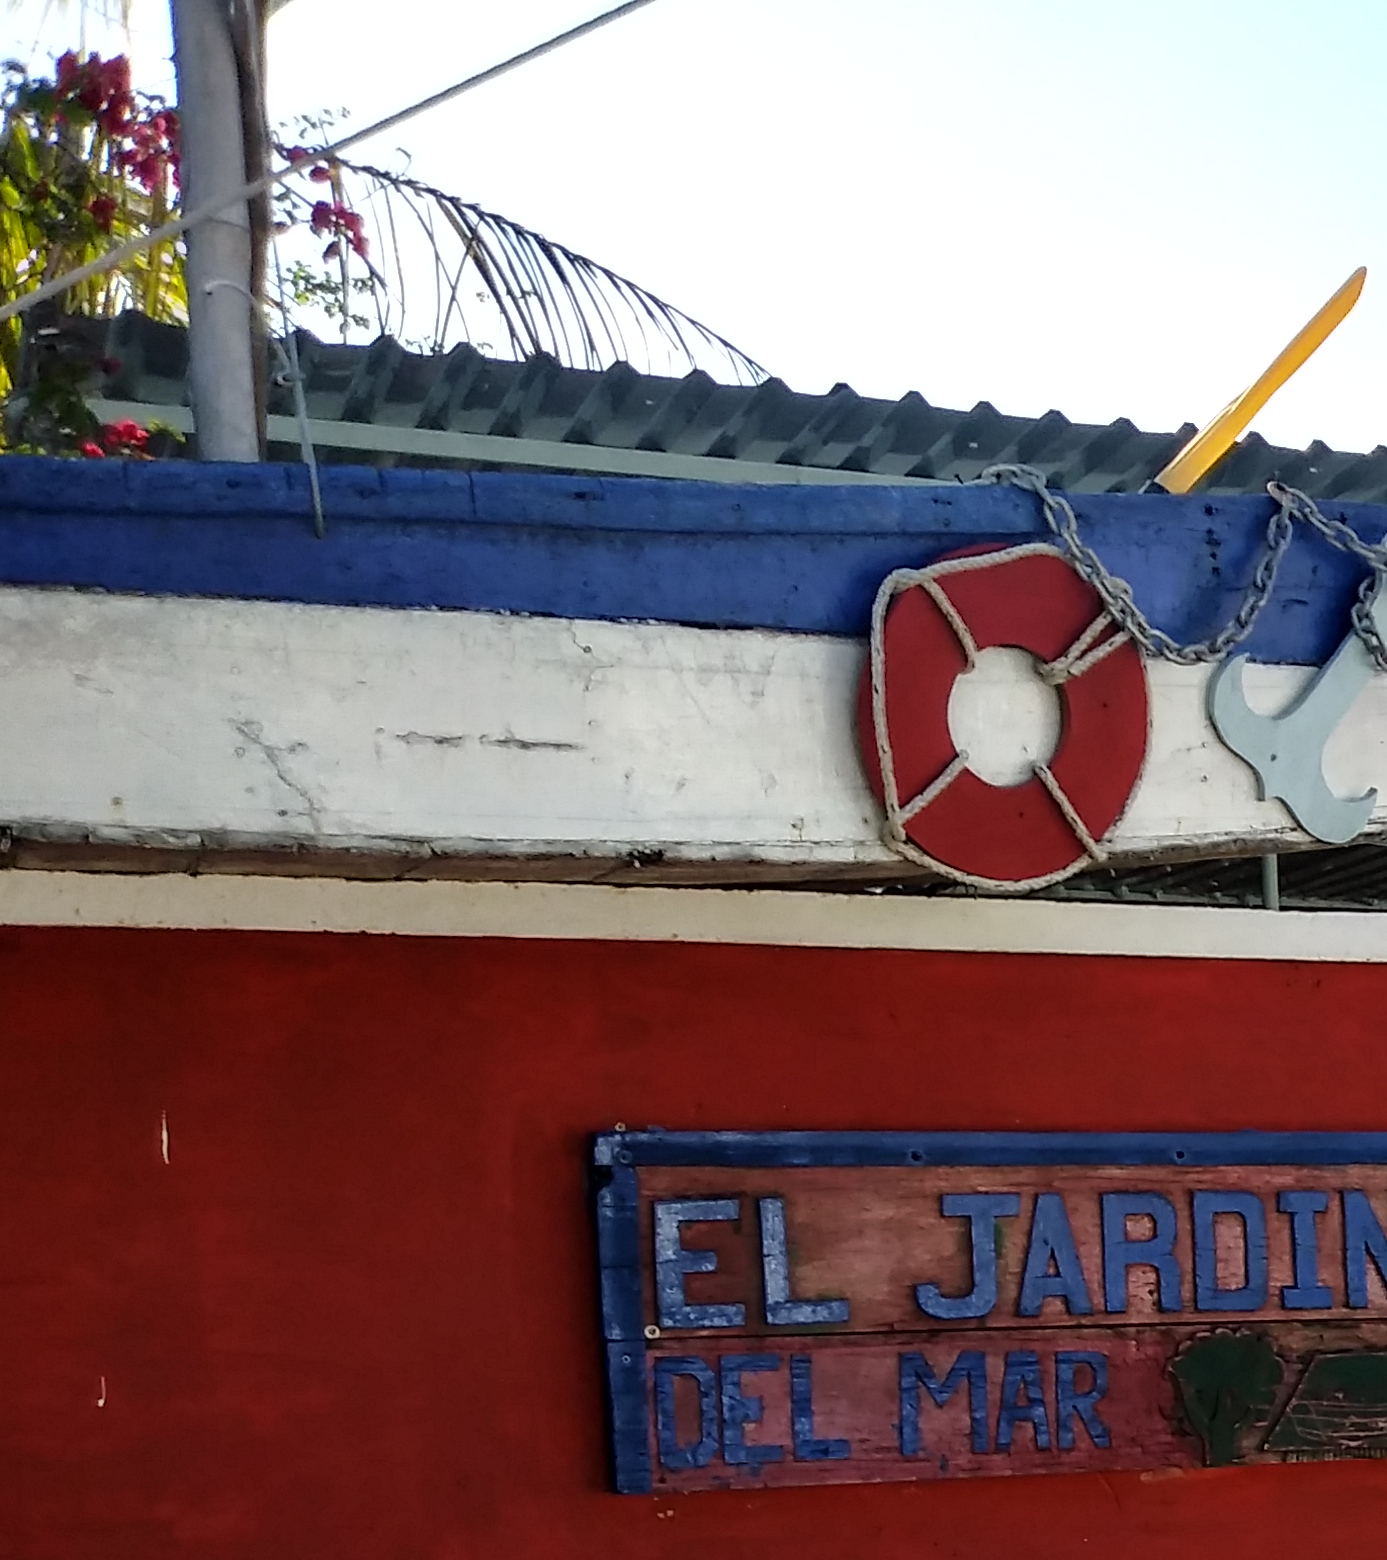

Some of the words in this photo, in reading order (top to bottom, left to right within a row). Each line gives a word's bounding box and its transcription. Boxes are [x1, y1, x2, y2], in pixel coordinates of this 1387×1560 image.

[655, 1197, 849, 1327] EL
[656, 1353, 850, 1469] DEL
[898, 1350, 1112, 1457] MAR
